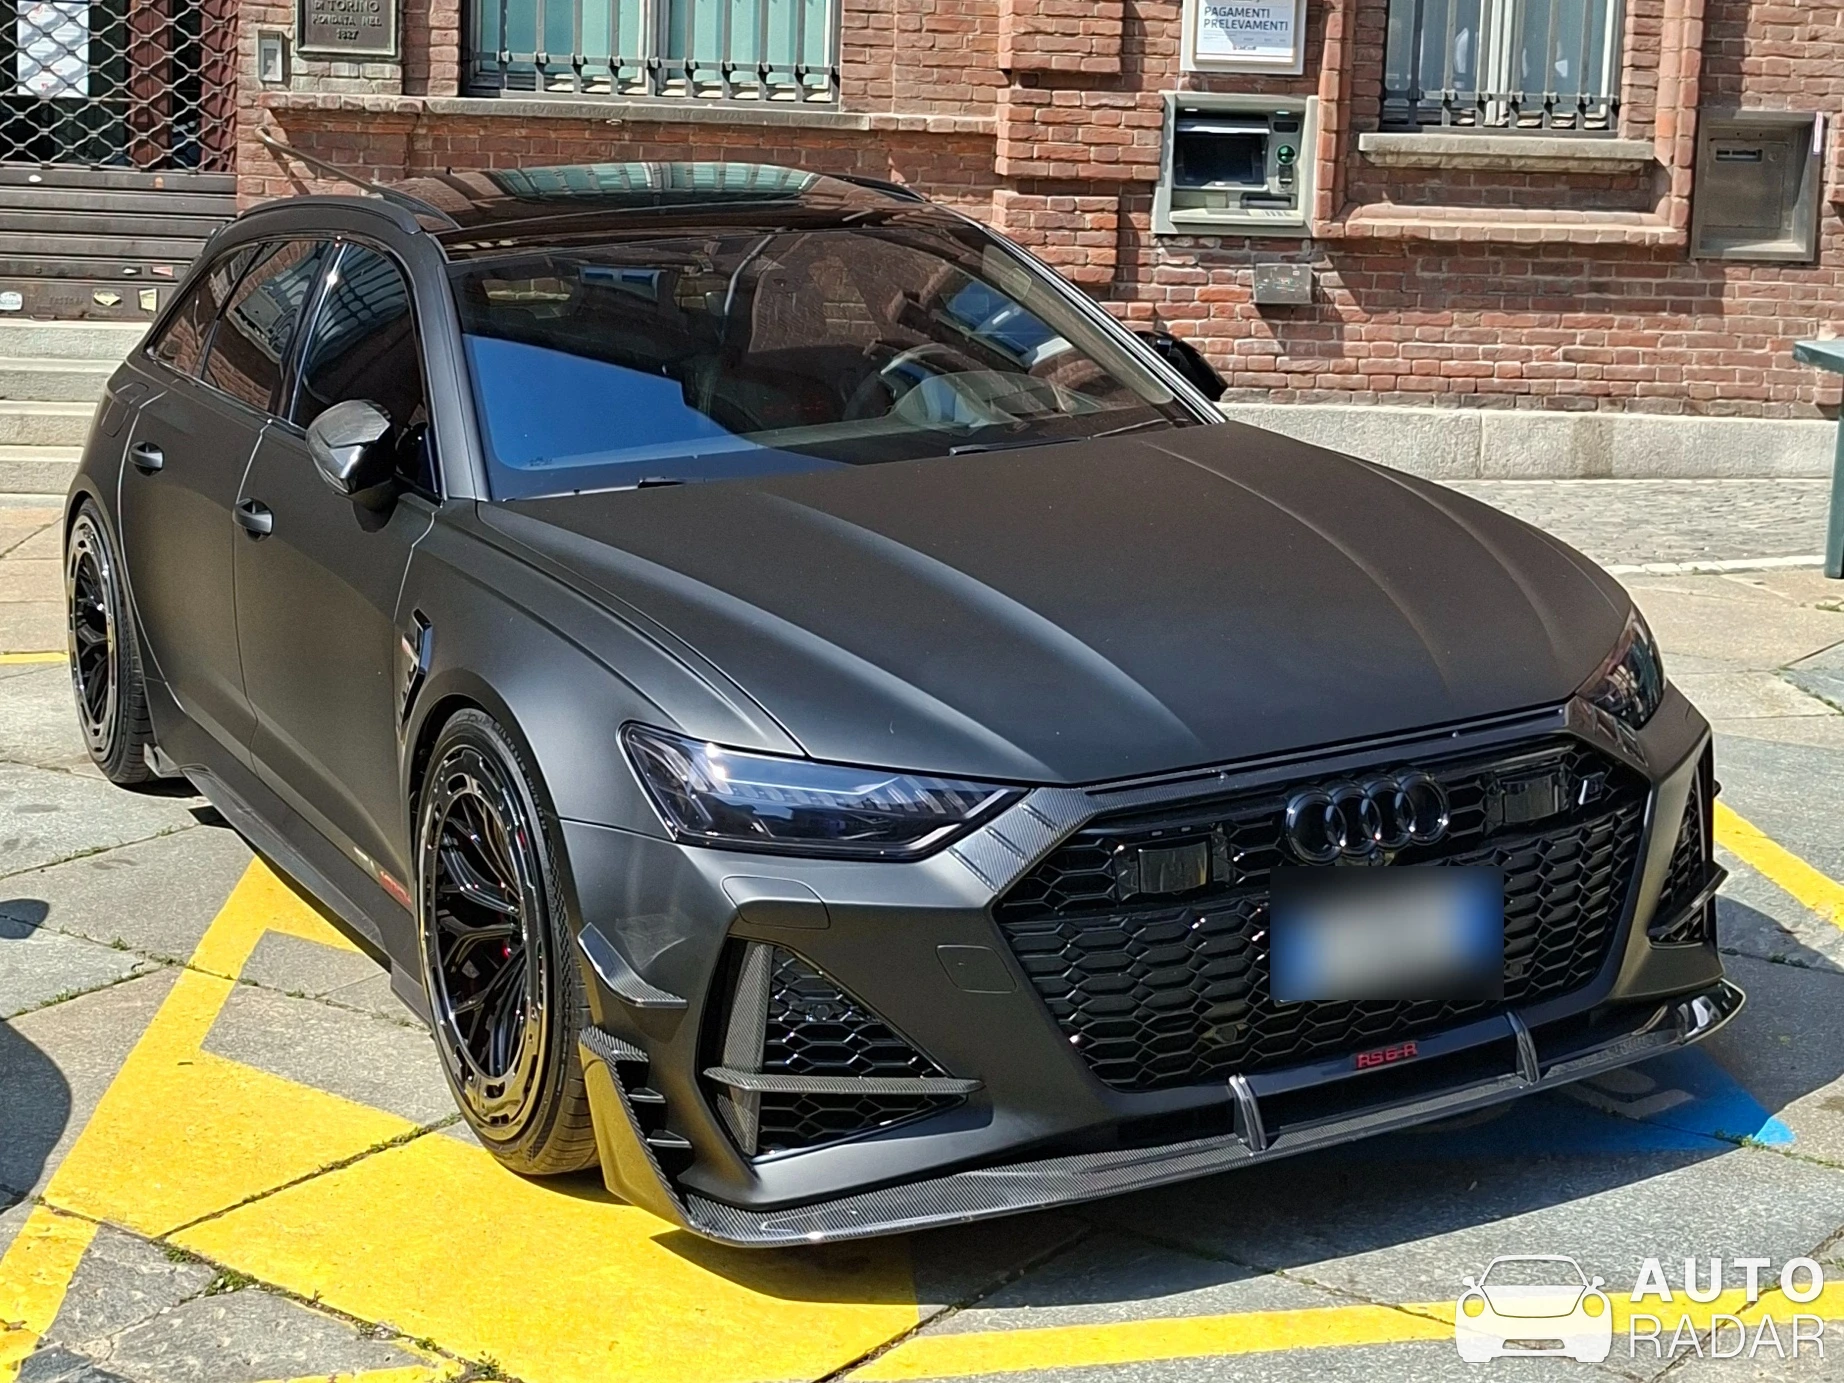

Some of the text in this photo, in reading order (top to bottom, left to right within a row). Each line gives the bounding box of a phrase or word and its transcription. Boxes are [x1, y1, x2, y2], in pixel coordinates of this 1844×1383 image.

[328, 0, 380, 13] TORINO
[1204, 6, 1270, 18] PAGAMENTI
[1203, 18, 1288, 31] PRELEVAMENTI
